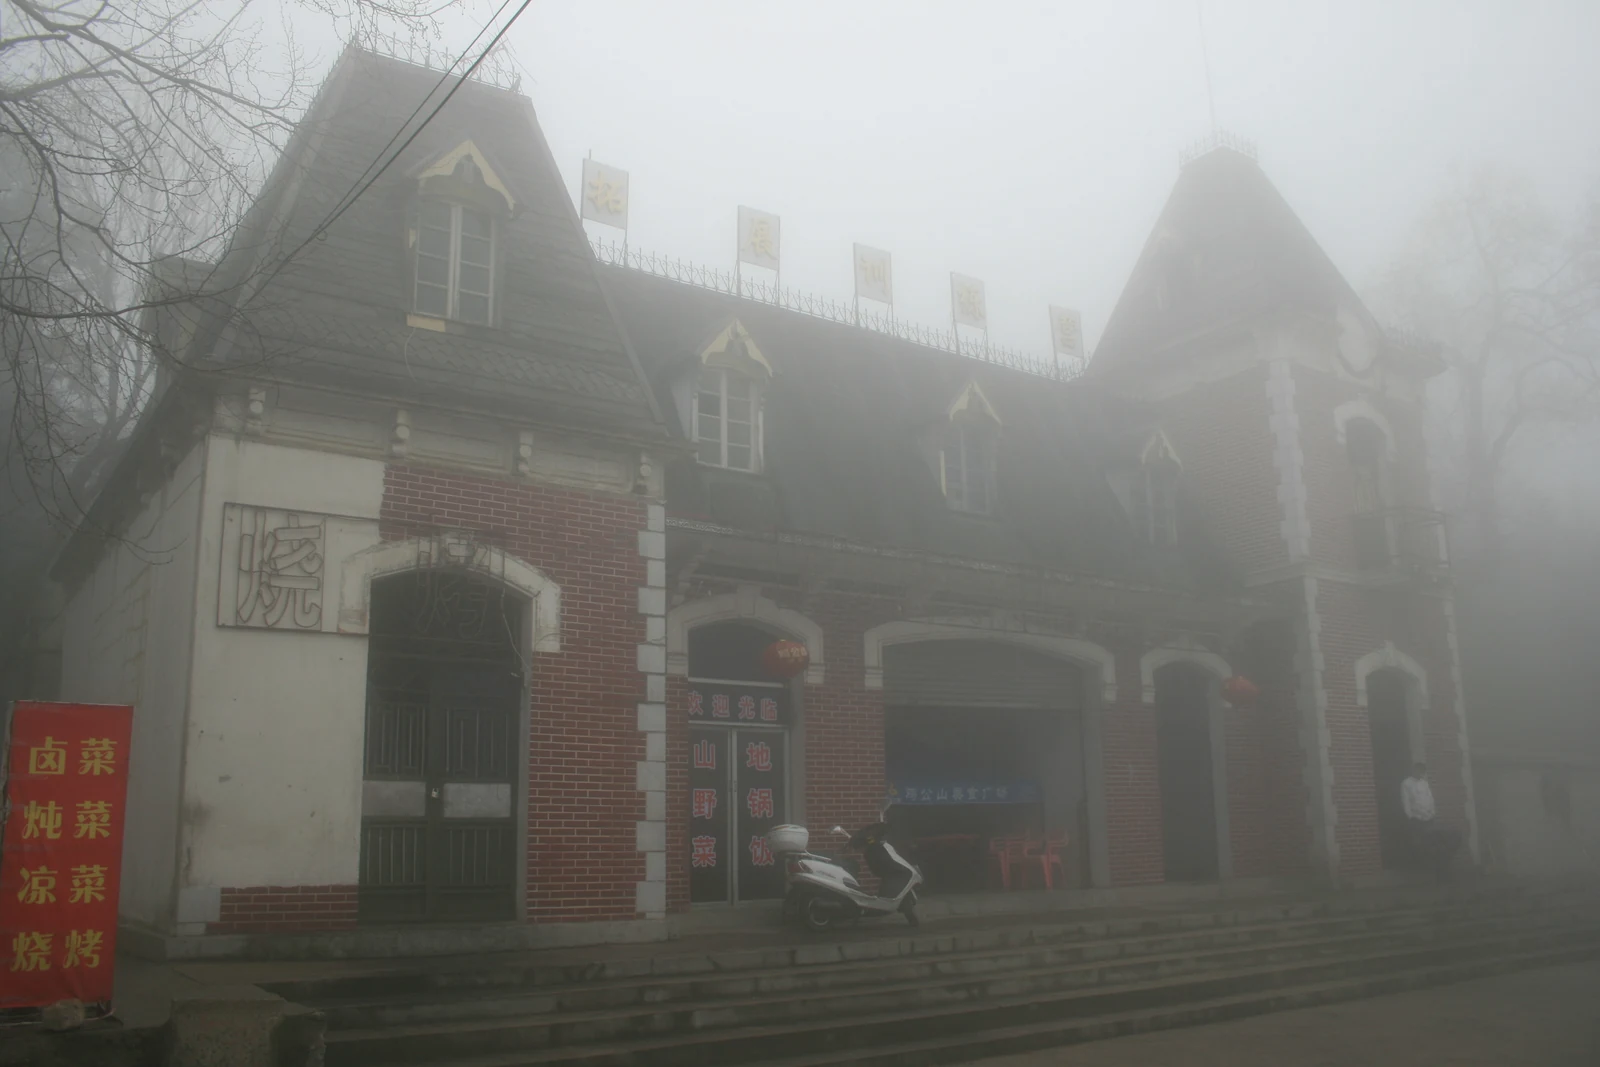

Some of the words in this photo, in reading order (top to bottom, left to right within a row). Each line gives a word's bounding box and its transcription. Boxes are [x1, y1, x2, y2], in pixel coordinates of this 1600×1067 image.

[688, 690, 777, 721] 欢迎光临
[28, 736, 118, 775] 卤菜
[22, 800, 113, 839] 炖菜
[692, 739, 717, 868] 山野菜
[747, 741, 775, 866] 地锅饭
[17, 864, 108, 904] 凉菜
[10, 929, 104, 972] 烧烤
